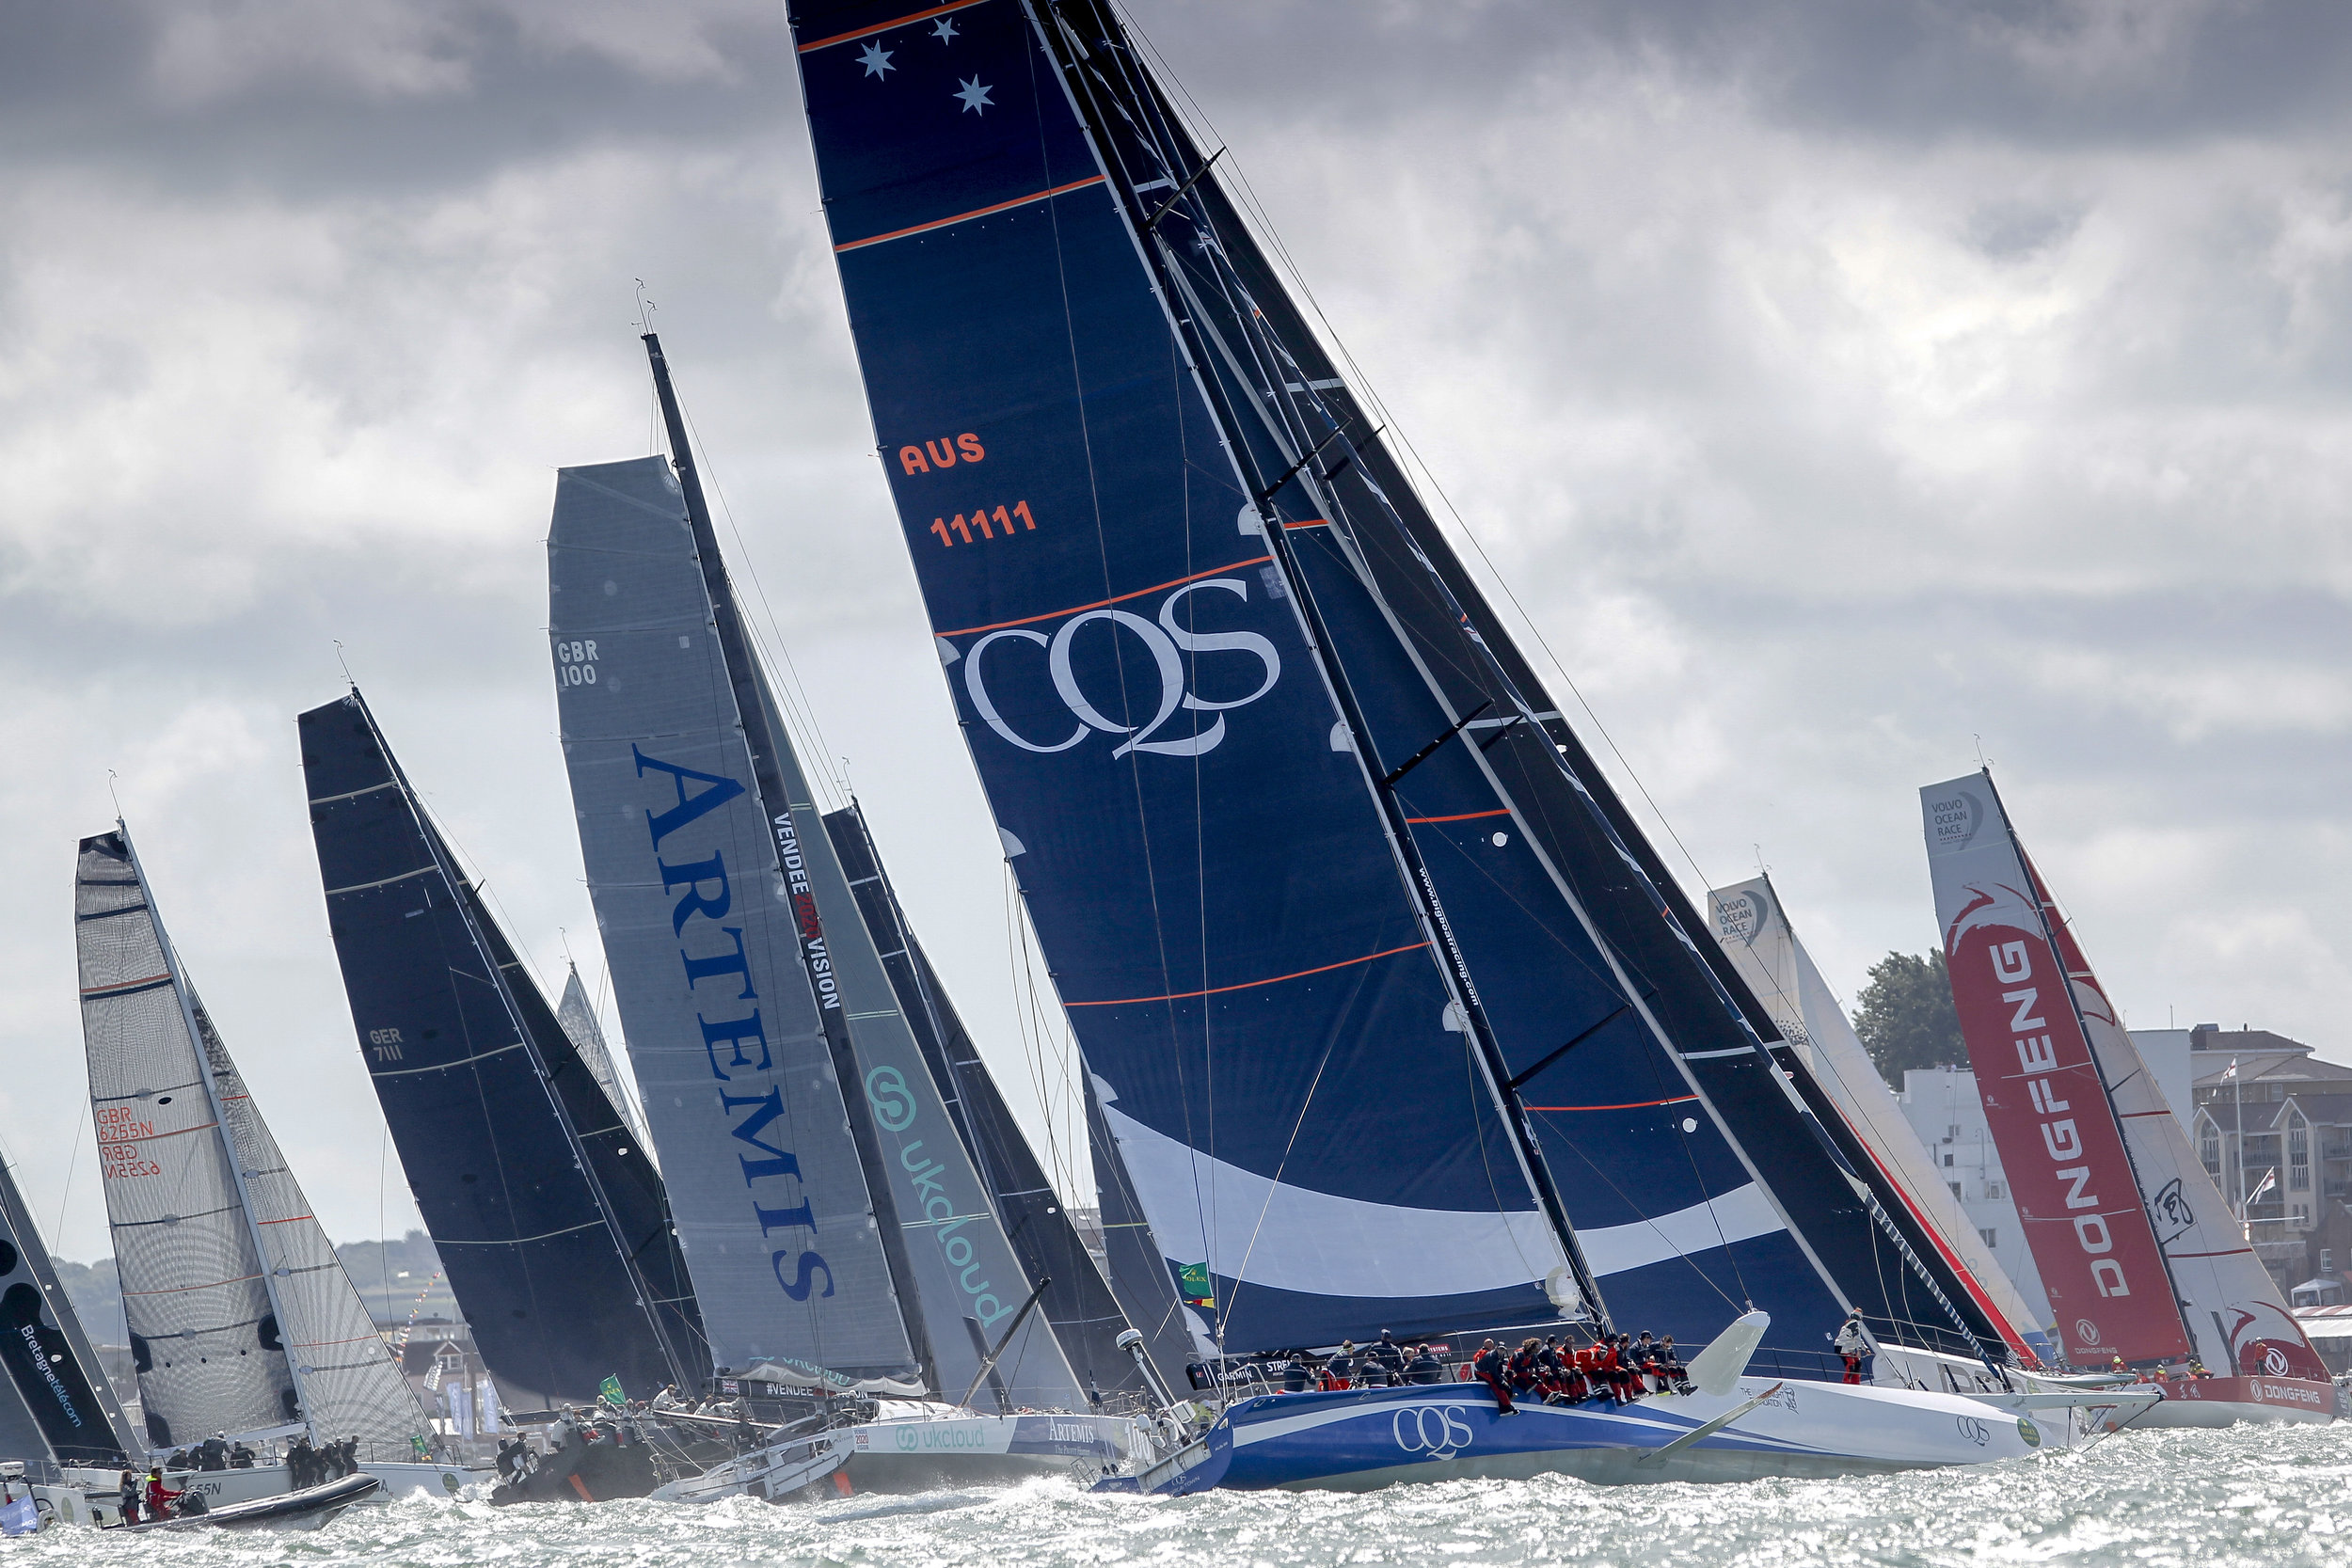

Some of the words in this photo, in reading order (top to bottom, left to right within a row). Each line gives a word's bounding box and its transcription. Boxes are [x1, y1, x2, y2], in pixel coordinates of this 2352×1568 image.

[898, 432, 986, 476] AUS
[930, 499, 1037, 547] 11111
[557, 640, 600, 663] GBR
[561, 664, 597, 687] 100
[964, 578, 1281, 760] CQS
[1931, 799, 1963, 814] VOLVO
[1934, 810, 1968, 826] OCEAN
[1937, 823, 1963, 837] RACE
[774, 812, 810, 895] VENDEE
[807, 937, 841, 1010] VISION
[1714, 897, 1748, 914] VOLVO
[1719, 909, 1754, 926] OCEAN
[1418, 866, 1479, 1006] www.bigboatracing.com
[1722, 921, 1749, 937] RACE
[630, 742, 836, 1303] ARTEMIS
[369, 1028, 405, 1044] GER
[373, 1044, 404, 1062] 7111
[97, 1106, 133, 1125] GBR
[1988, 939, 2131, 1298] DONGFENG
[99, 1120, 154, 1141] 6255N
[899, 1140, 1014, 1330] ukcloud
[1216, 1370, 1254, 1382] GARMIN
[1740, 1386, 1753, 1396] THE
[2264, 1384, 2321, 1404] DONGFENG
[855, 1434, 869, 1445] 2020
[922, 1424, 986, 1449] ukcloud
[1393, 1404, 1473, 1461] CQS
[1957, 1416, 1991, 1447] CQS
[1171, 1473, 1187, 1486] CQS
